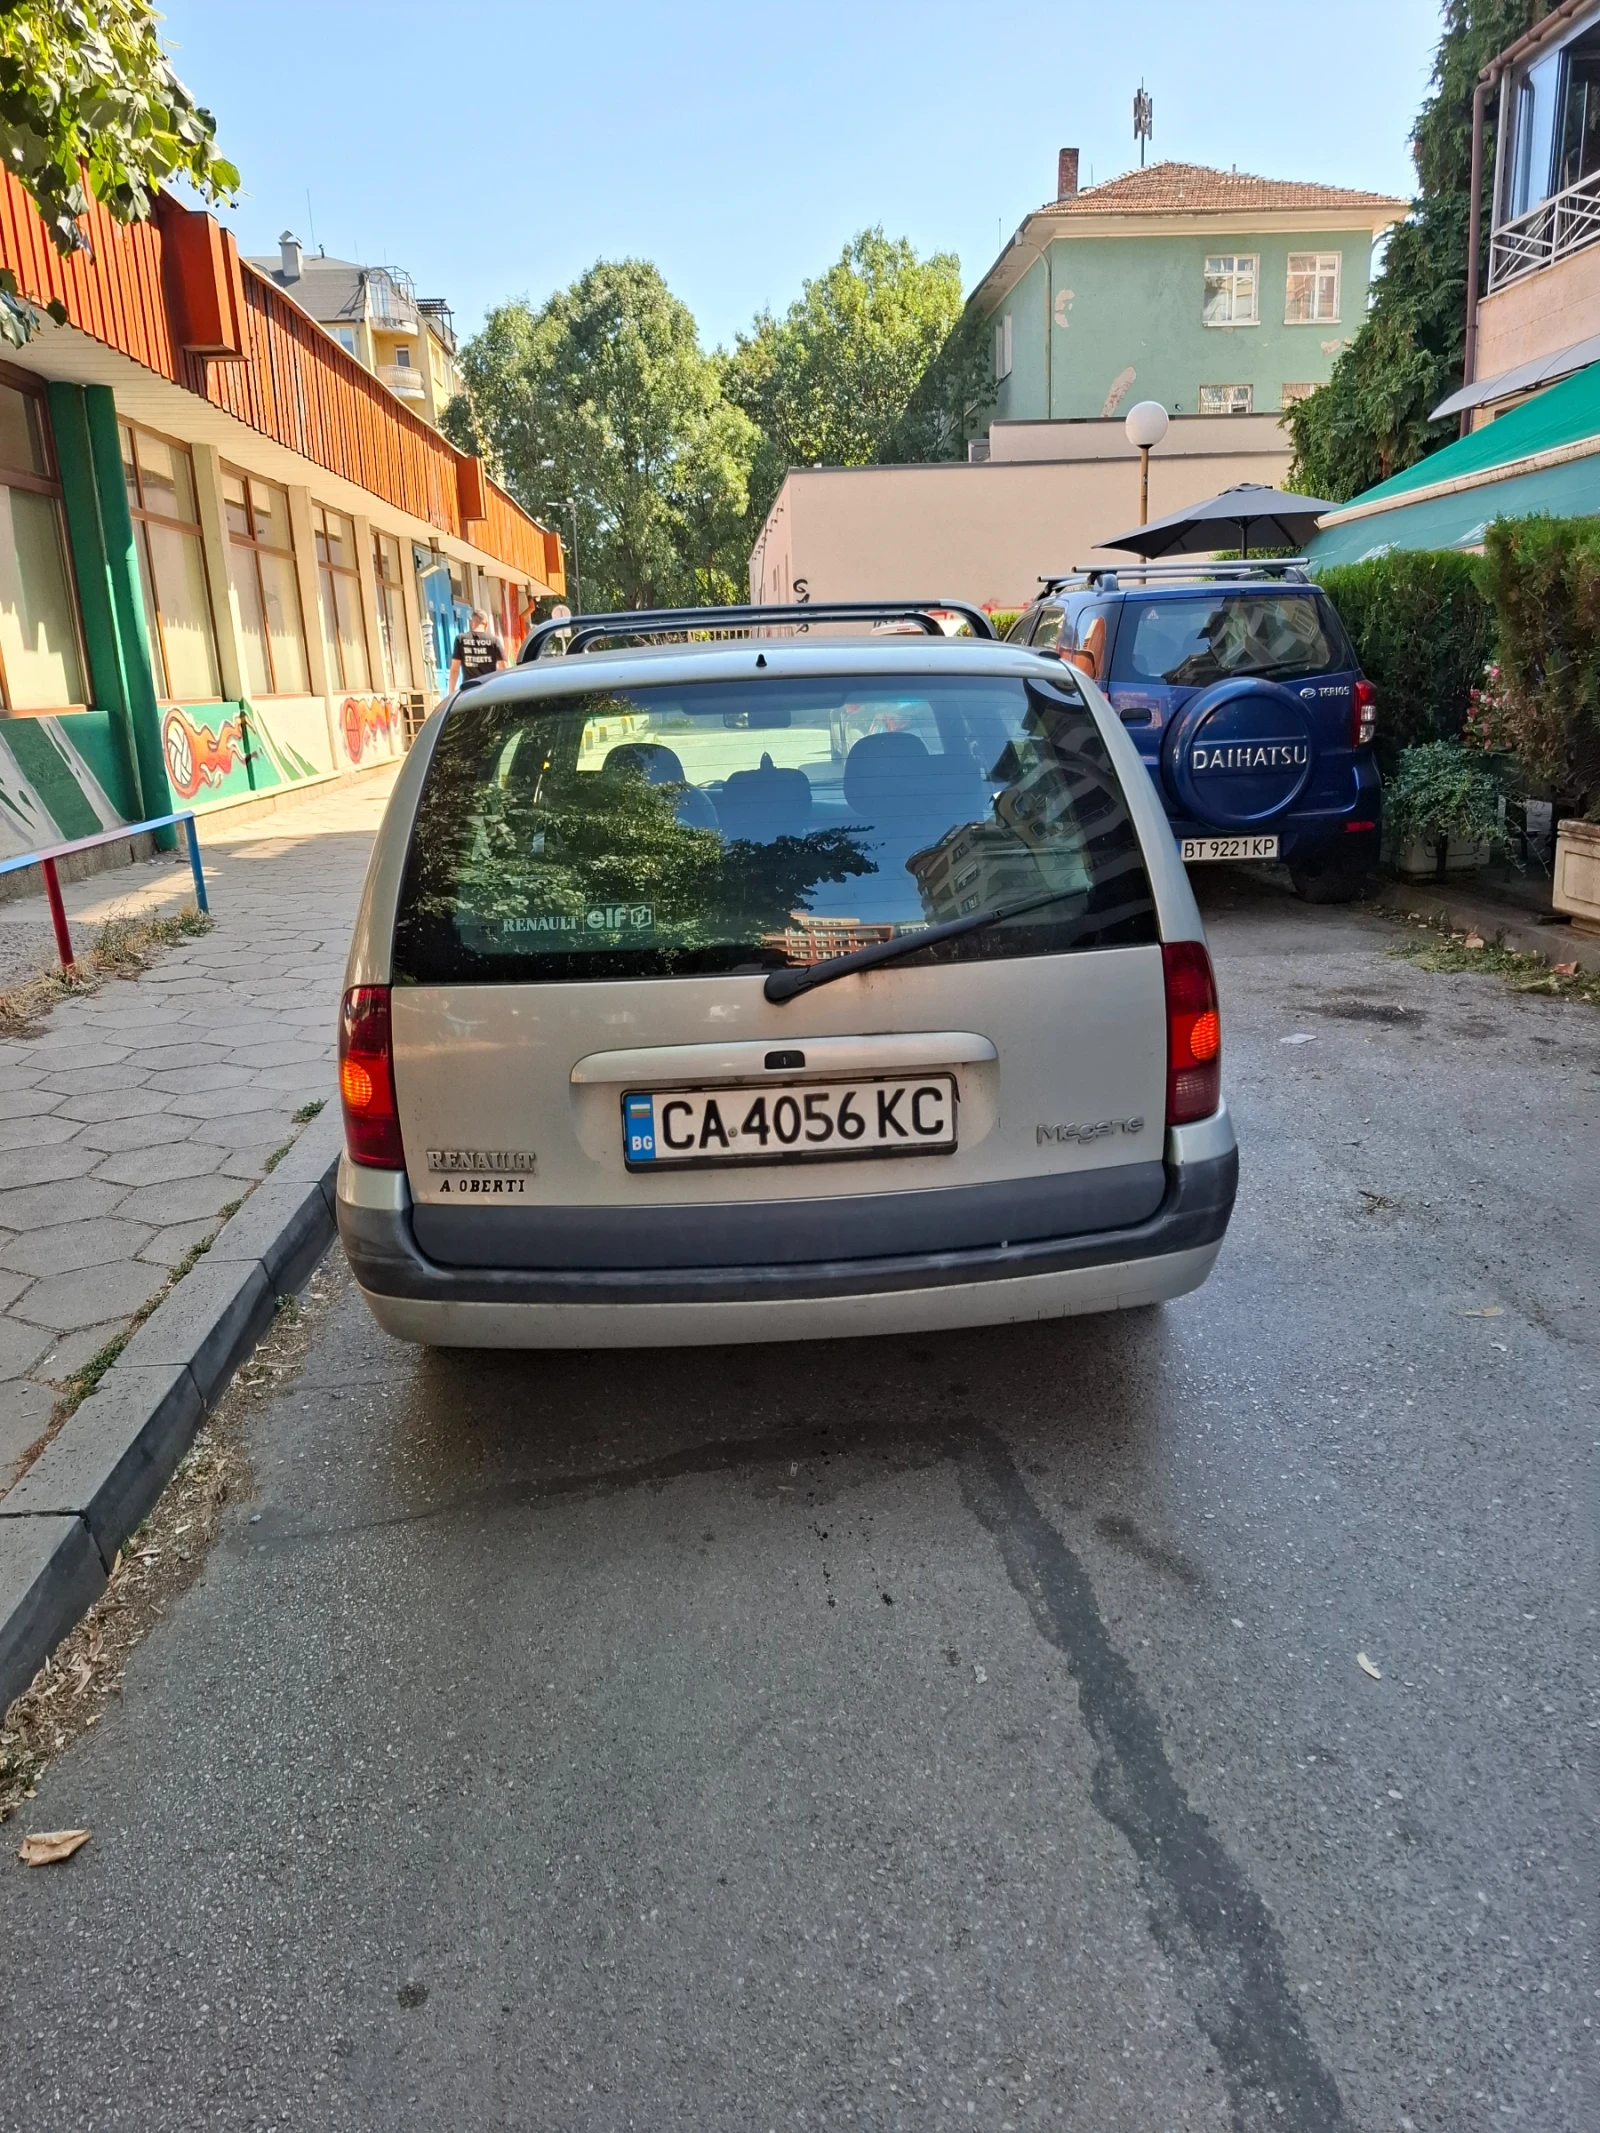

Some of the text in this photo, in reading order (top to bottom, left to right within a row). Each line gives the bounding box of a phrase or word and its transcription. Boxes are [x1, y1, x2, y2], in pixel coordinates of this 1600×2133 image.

[474, 647, 487, 655] THE
[1318, 685, 1350, 697] TERIOS
[1192, 745, 1307, 770] DAIHATSU
[1184, 838, 1275, 858] BT 9221 KP
[502, 916, 578, 932] RENAULT
[586, 907, 627, 929] elf
[661, 1086, 945, 1150] CA 4056 KC
[631, 1135, 653, 1151] BG
[426, 1150, 536, 1173] RENAULT
[459, 1179, 525, 1193] OBERTI
